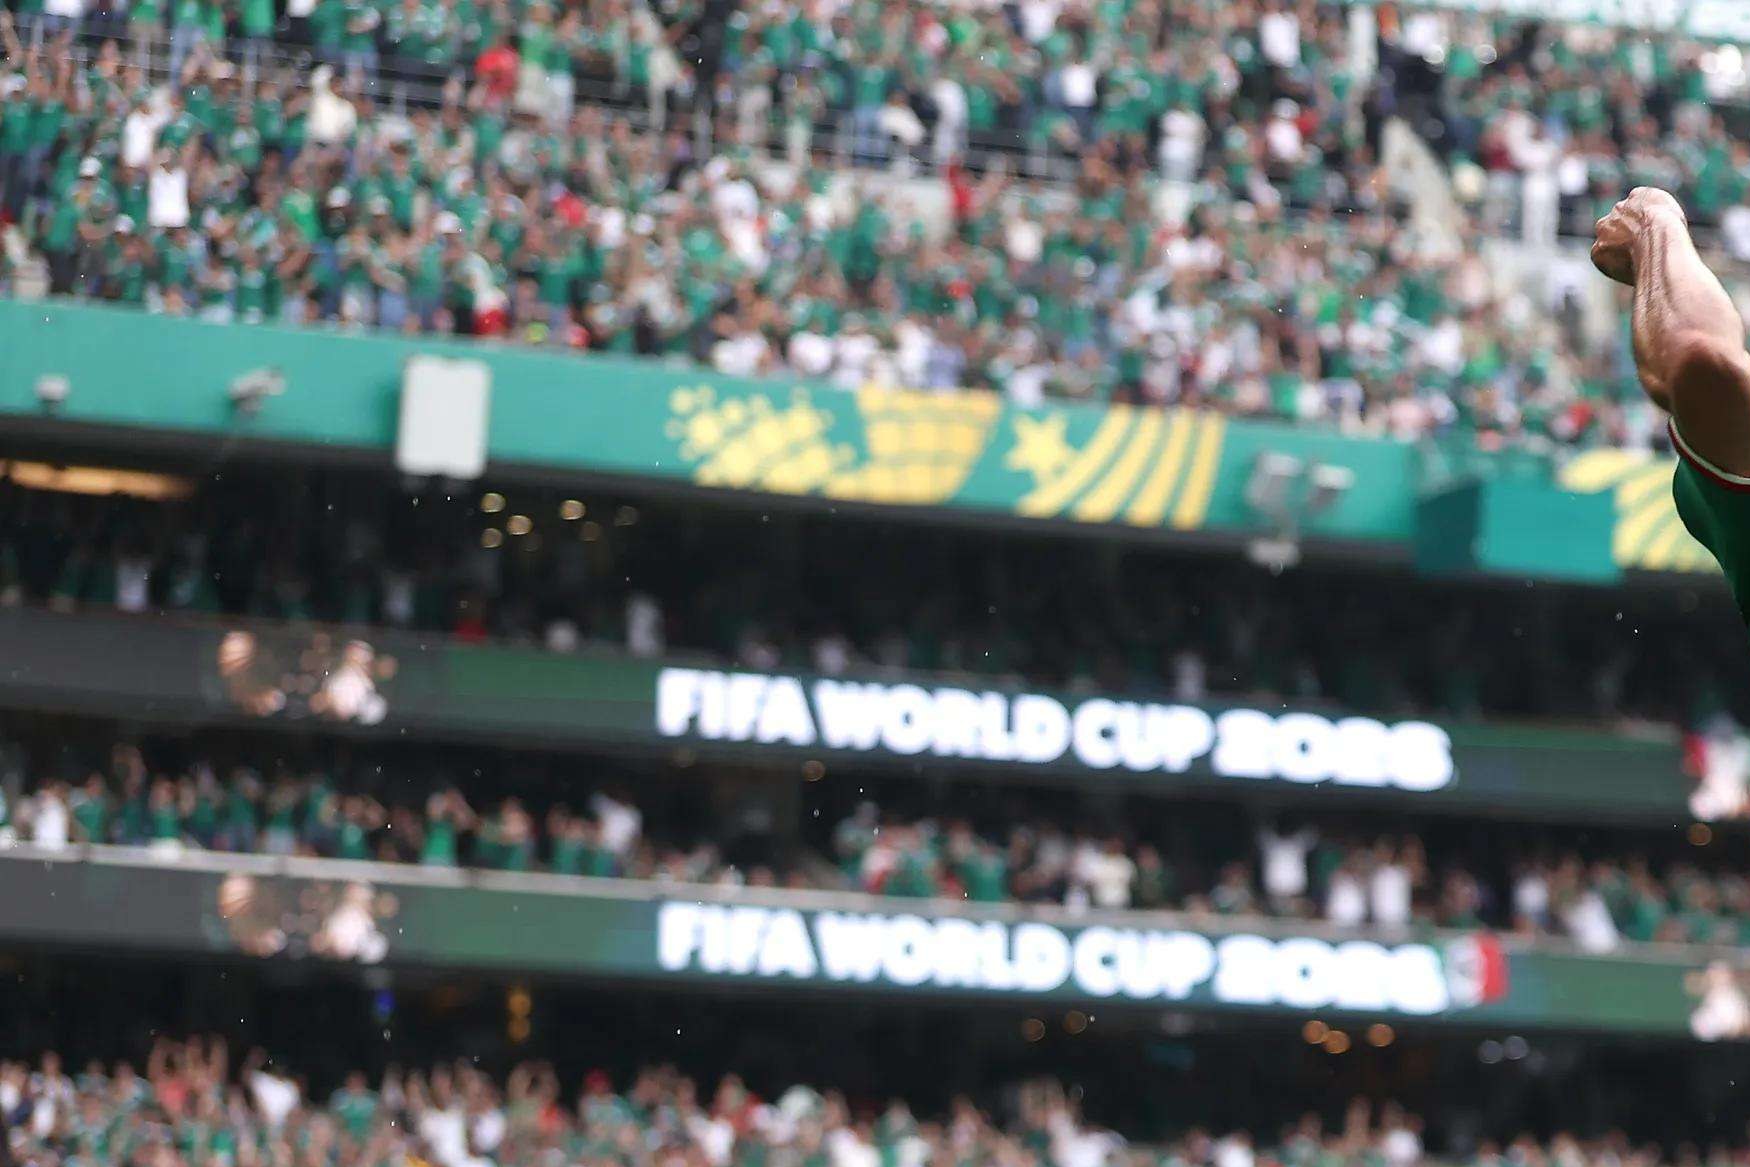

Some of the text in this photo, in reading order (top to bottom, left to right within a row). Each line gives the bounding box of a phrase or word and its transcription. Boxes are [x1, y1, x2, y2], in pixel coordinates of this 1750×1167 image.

[656, 667, 1455, 792] FIFA WORLD CUP 2026
[658, 901, 819, 979] FIFA
[814, 911, 1071, 992] WORLD
[1074, 926, 1218, 1000] CUP
